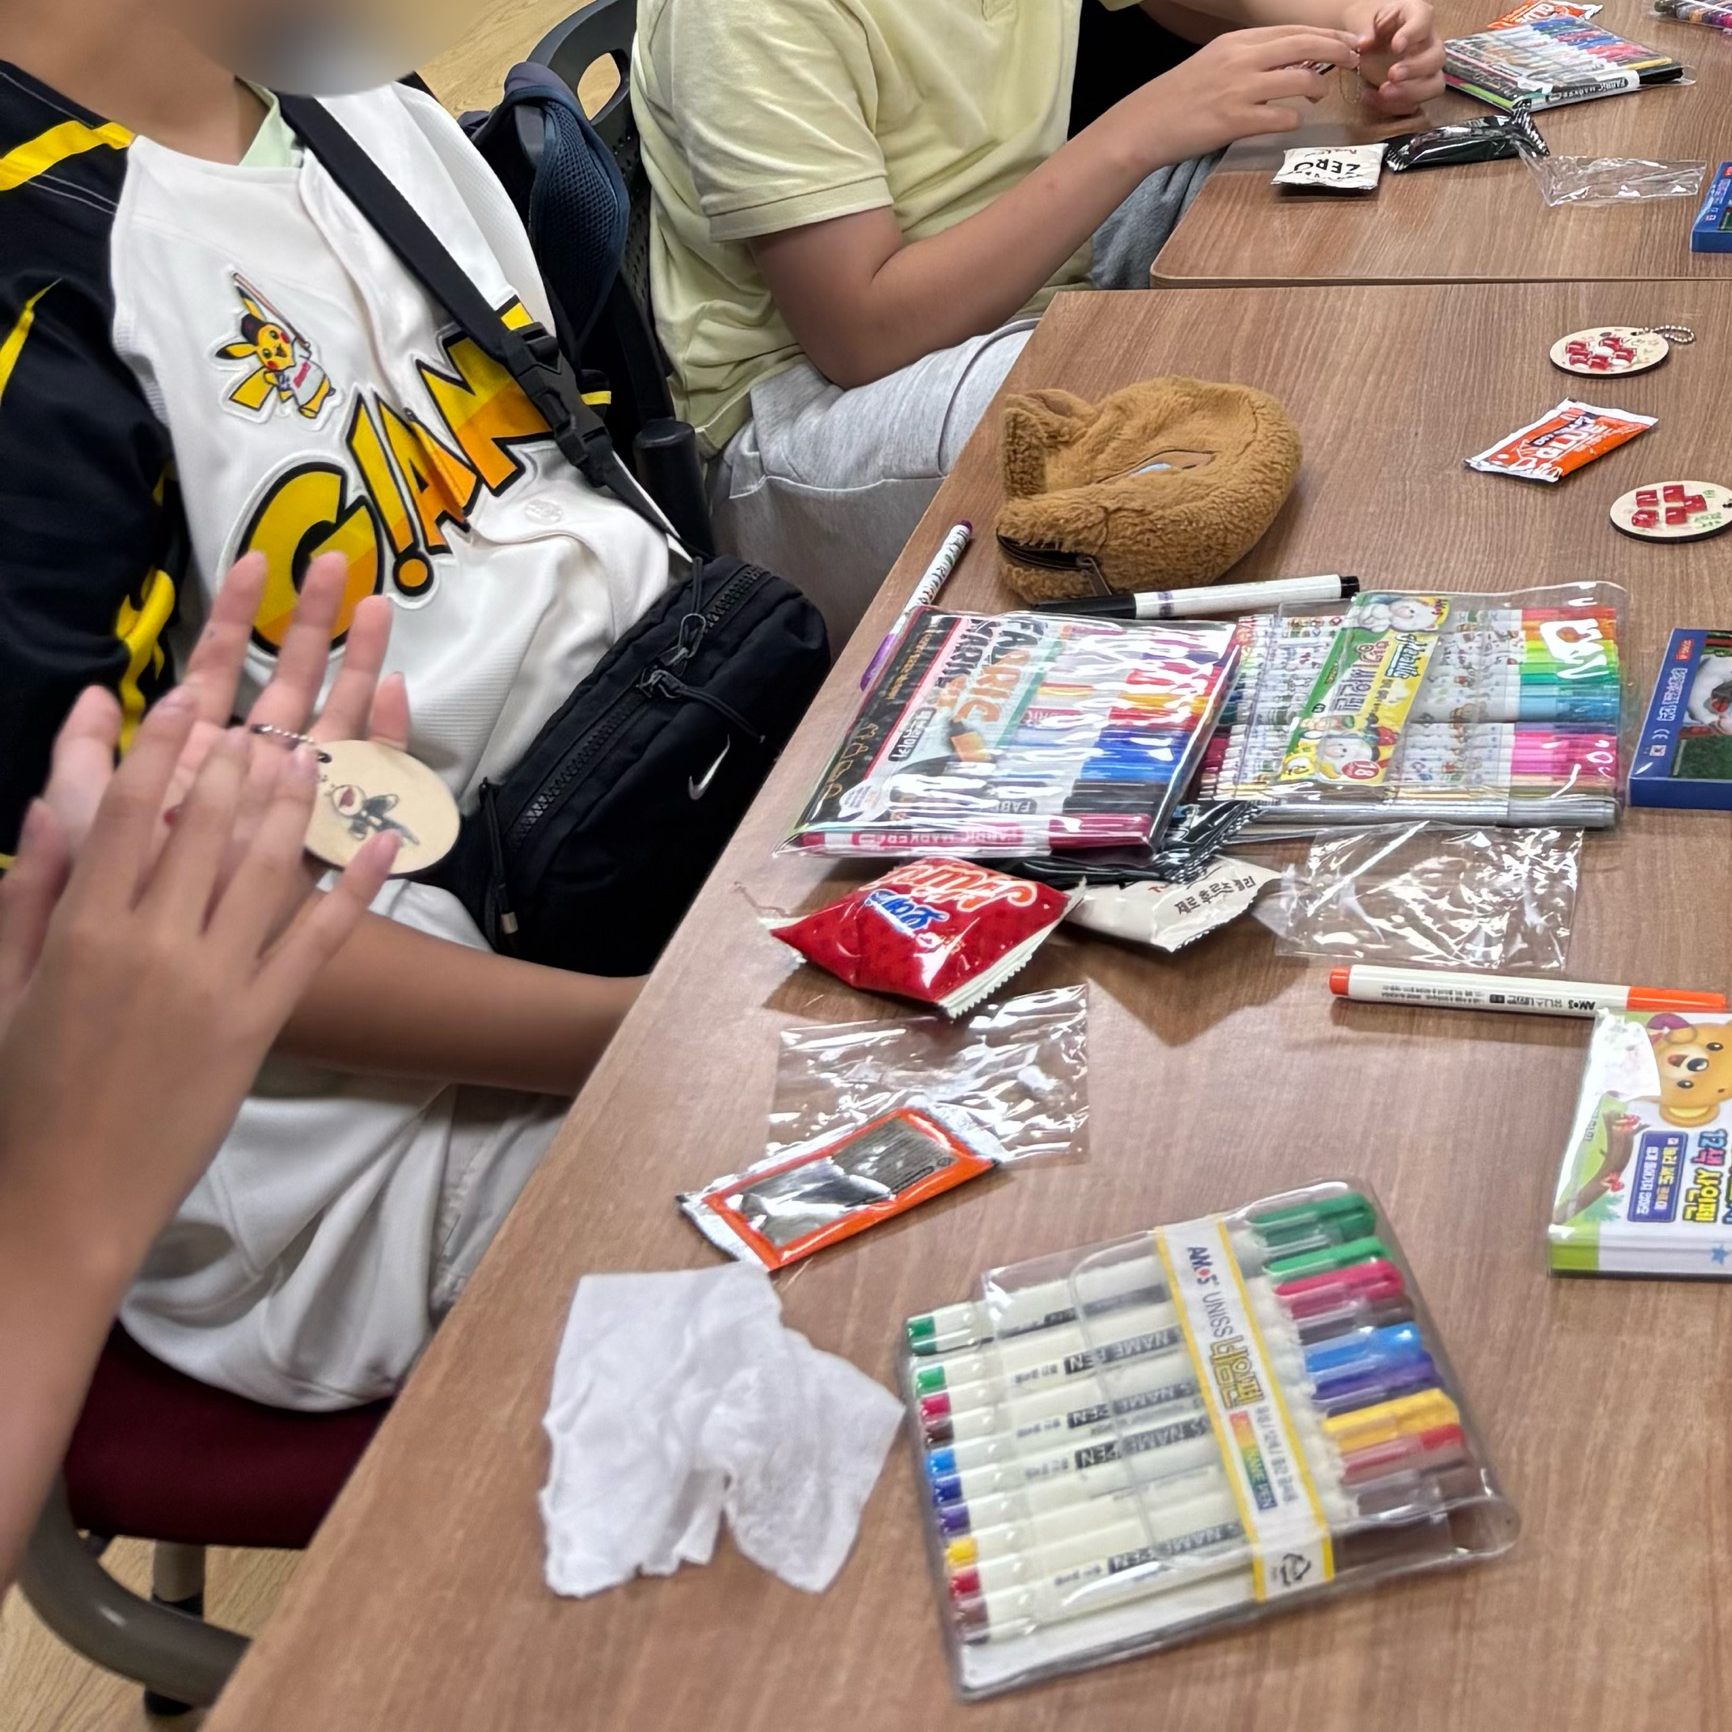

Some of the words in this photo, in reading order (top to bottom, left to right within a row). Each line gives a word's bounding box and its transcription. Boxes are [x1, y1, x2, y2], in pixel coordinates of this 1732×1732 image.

[1293, 159, 1360, 175] ZERO
[1537, 421, 1607, 459] GLUE
[953, 616, 1048, 726] FABRIC
[1692, 1130, 1728, 1165] 12색
[1684, 1168, 1721, 1222] 사인펜
[1202, 1291, 1233, 1340] UNISS
[1068, 1350, 1108, 1372] PEN
[1112, 1330, 1170, 1360] NAME
[1209, 1337, 1265, 1410] 네임펜
[1117, 1384, 1174, 1410] NAME
[1127, 1423, 1181, 1448] NAME
[1078, 1445, 1117, 1465] PEN
